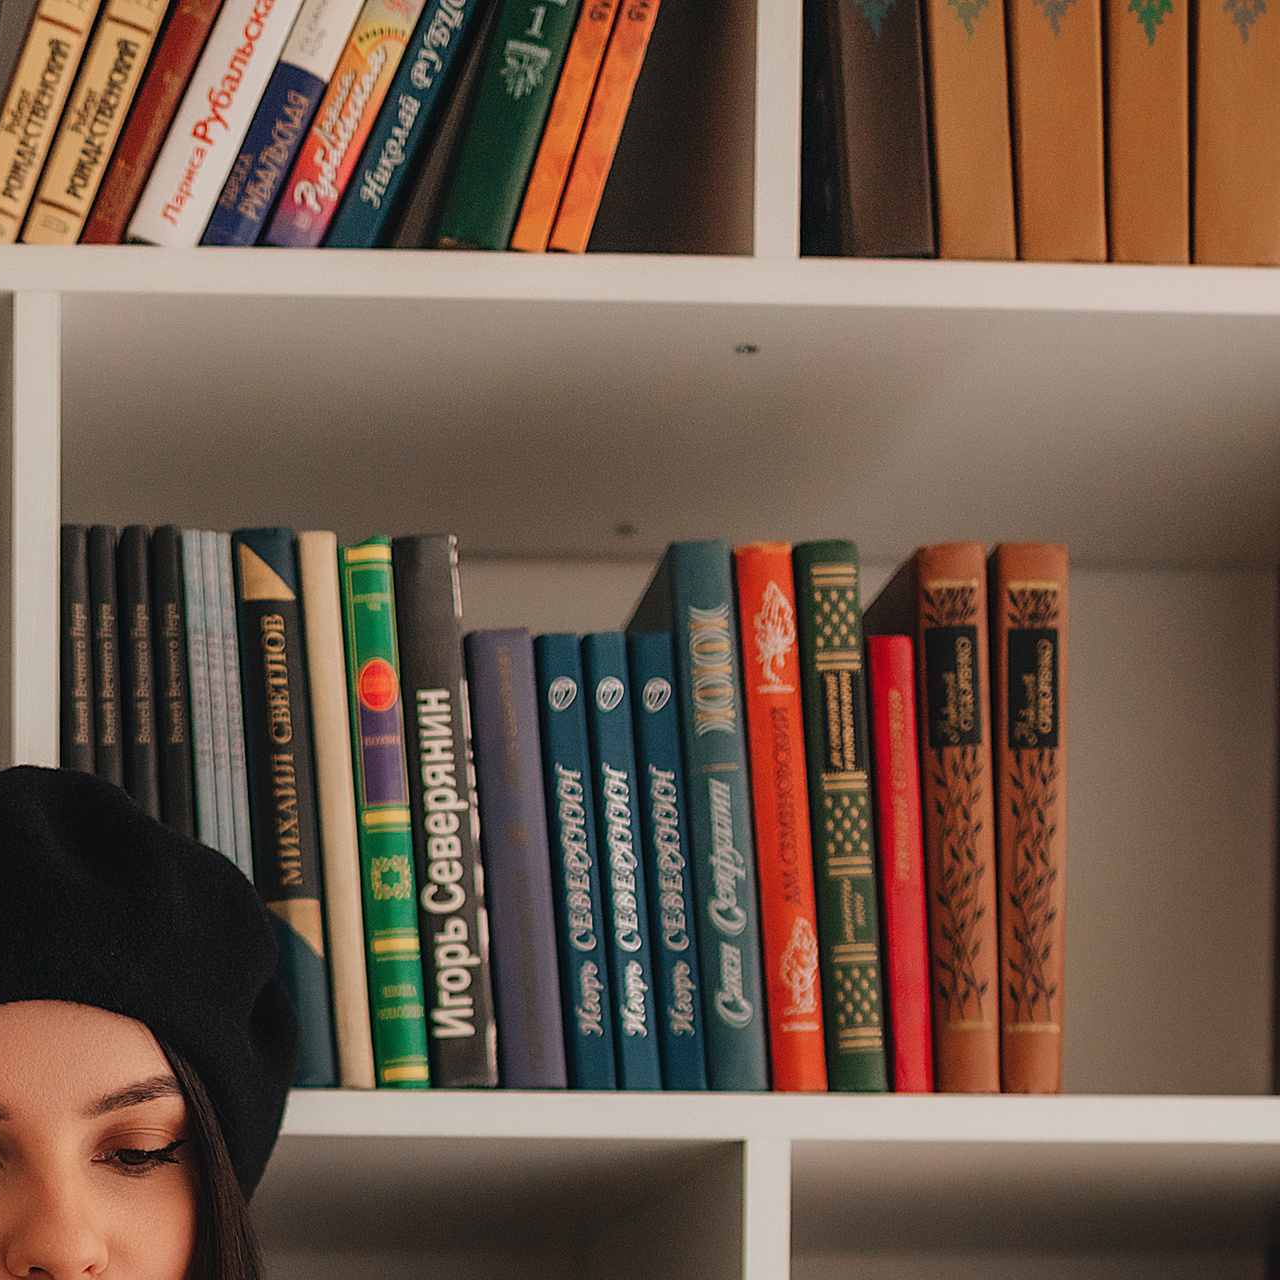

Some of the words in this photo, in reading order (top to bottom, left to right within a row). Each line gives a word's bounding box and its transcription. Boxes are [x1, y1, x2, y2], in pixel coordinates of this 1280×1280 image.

[162, 146, 206, 226] Лариса
[360, 94, 421, 210] Николай
[258, 612, 295, 745] СВЕТЛОВ
[269, 751, 305, 887] МИХАИЛ
[415, 688, 469, 915] Северянин
[553, 761, 598, 952] СЕВЕРЯНИН
[601, 761, 644, 953] СЕВЕРЯНИН
[648, 762, 691, 952] СЕВЕРЯНИН
[431, 916, 481, 1039] Игорь
[574, 959, 604, 1038] Игорь
[620, 959, 649, 1038] Игорь
[668, 959, 696, 1038] Игорь
